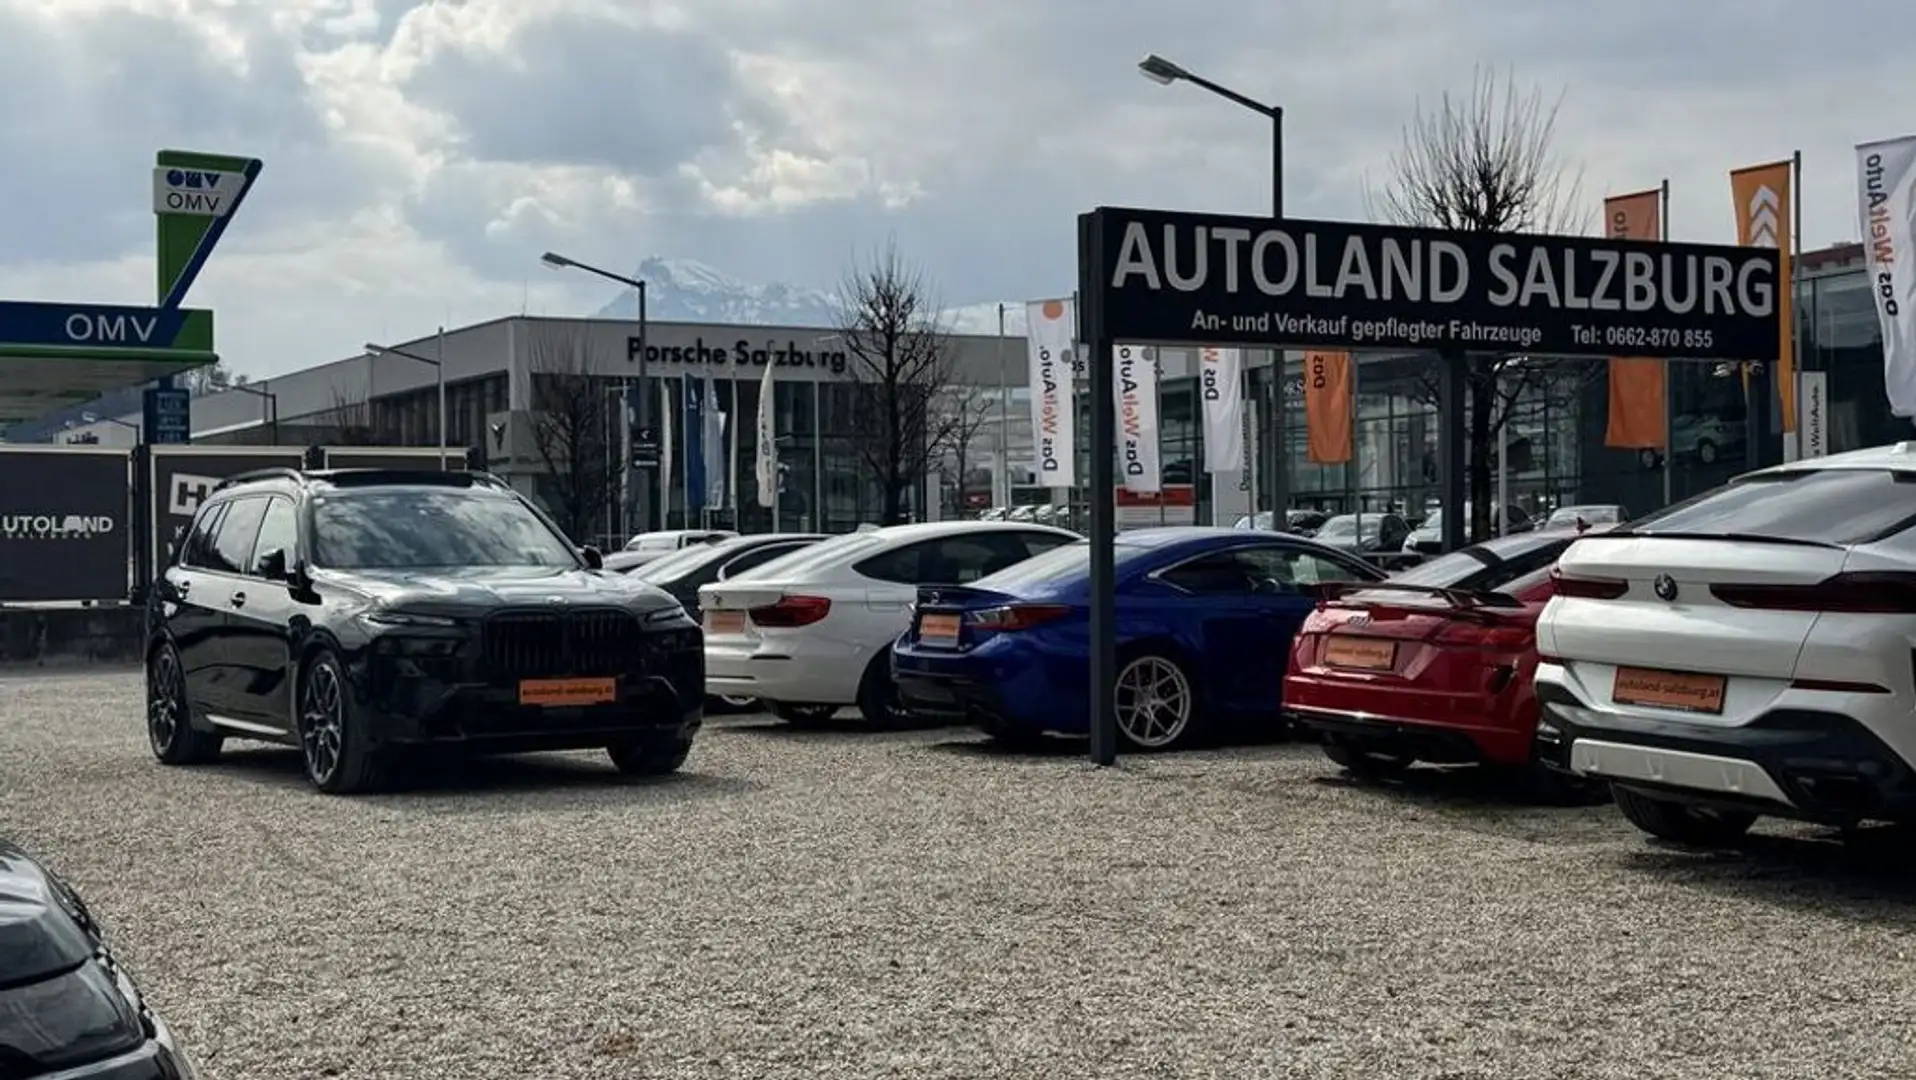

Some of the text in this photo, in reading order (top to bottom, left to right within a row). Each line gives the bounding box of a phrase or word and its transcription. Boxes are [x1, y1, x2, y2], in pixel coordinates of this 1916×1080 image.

[166, 192, 220, 212] OMV
[1111, 221, 1774, 318] AUTOLAND SALZBURG
[66, 313, 157, 342] OMV
[1191, 309, 1542, 346] An- und Verkauf gepflegter Fahrzeuge
[1570, 325, 1714, 347] Tel: 0662-870 855
[627, 336, 846, 373] Porsche Sazbrg
